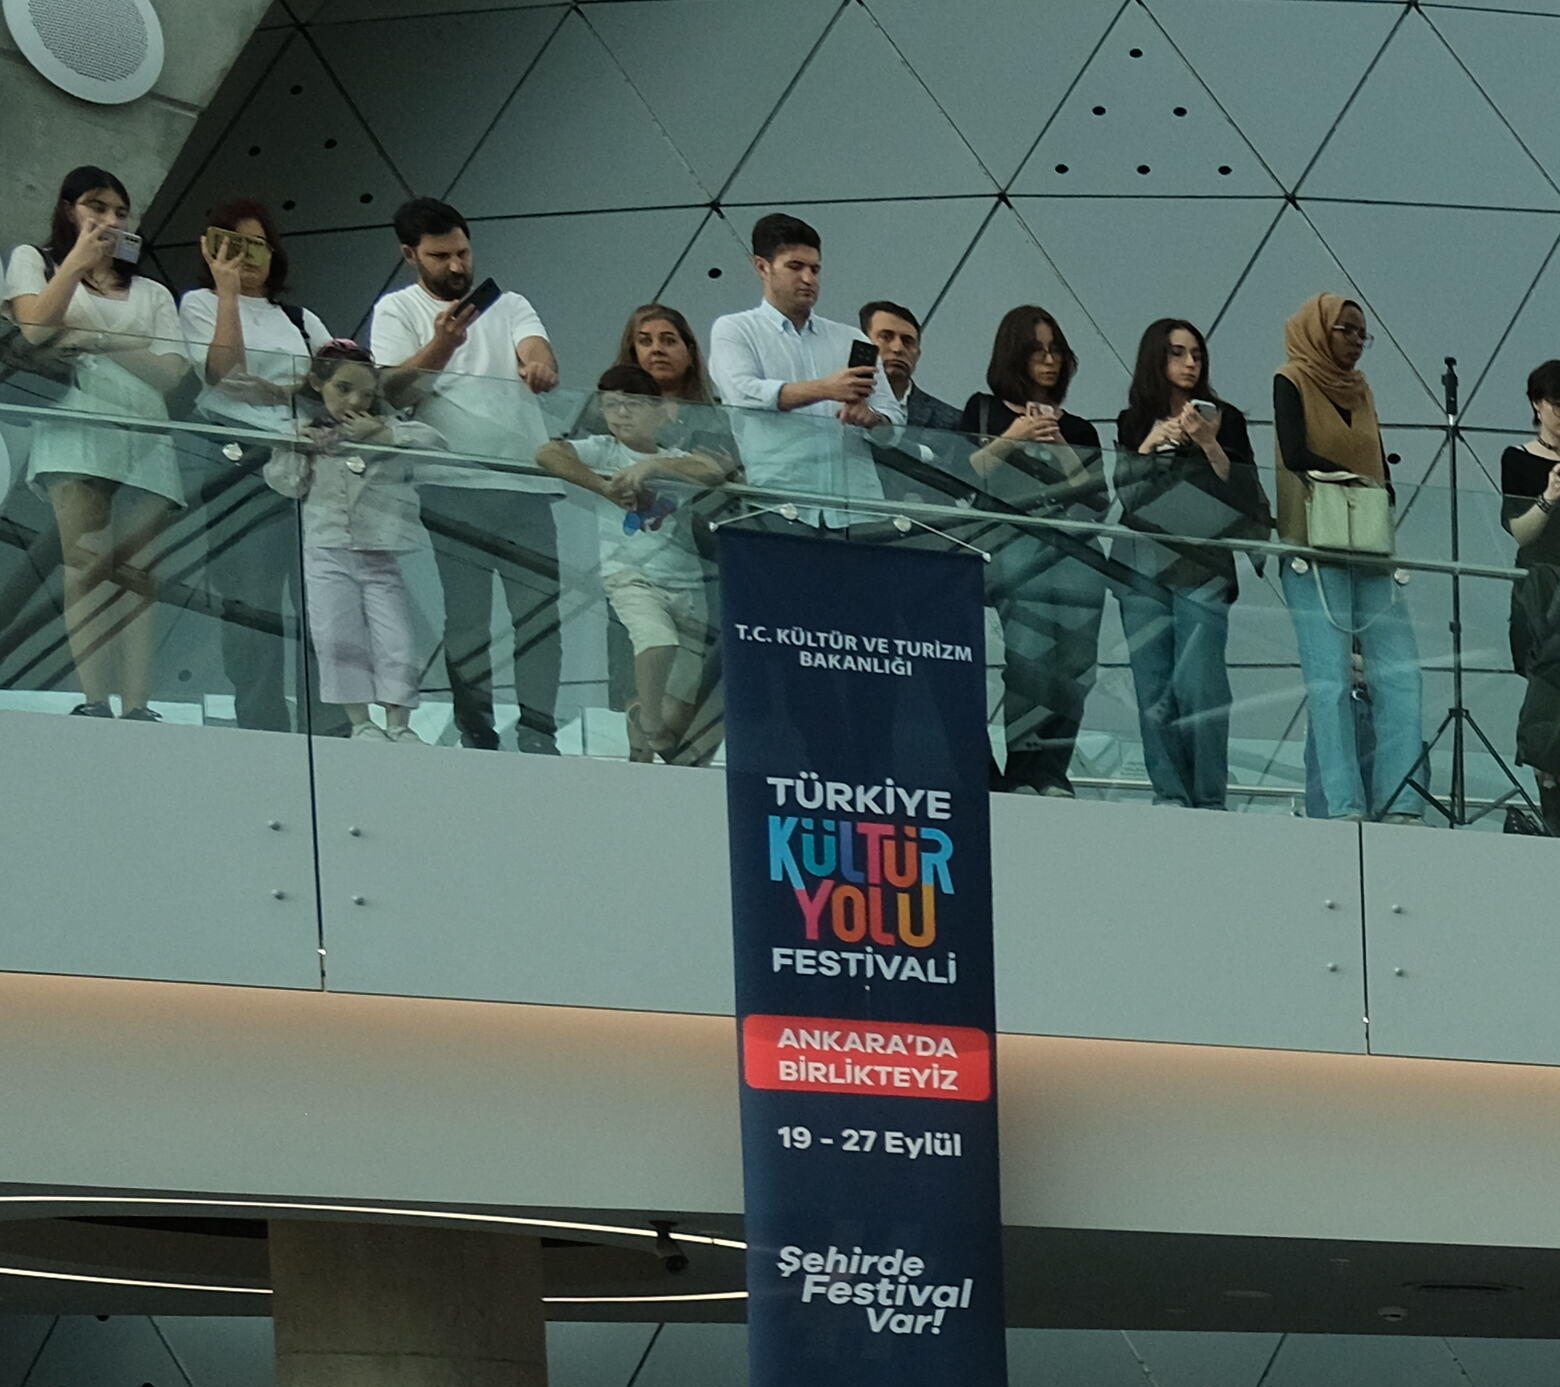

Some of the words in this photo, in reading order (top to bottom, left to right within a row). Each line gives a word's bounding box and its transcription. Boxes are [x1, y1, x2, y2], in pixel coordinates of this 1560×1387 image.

[735, 624, 772, 643] T.C.
[777, 627, 857, 652] KÜLTÜR
[862, 636, 888, 653] VE
[896, 639, 972, 662] TURİZM
[799, 652, 912, 676] BAKANLIĞI
[766, 772, 952, 820] TÜRKİYE
[768, 816, 954, 895] KÜLTÜR
[795, 880, 936, 948] YOLU
[772, 946, 957, 984] FESTİVALİ
[777, 1028, 958, 1058] ANKARA'DA
[779, 1056, 958, 1091] BİRLİKTEYİZ
[777, 1127, 811, 1149] 19
[841, 1130, 875, 1152] 27
[885, 1132, 961, 1159] Eylül
[776, 1246, 925, 1277] Şehirde
[801, 1276, 973, 1309] Festival
[866, 1307, 946, 1335] Var!
